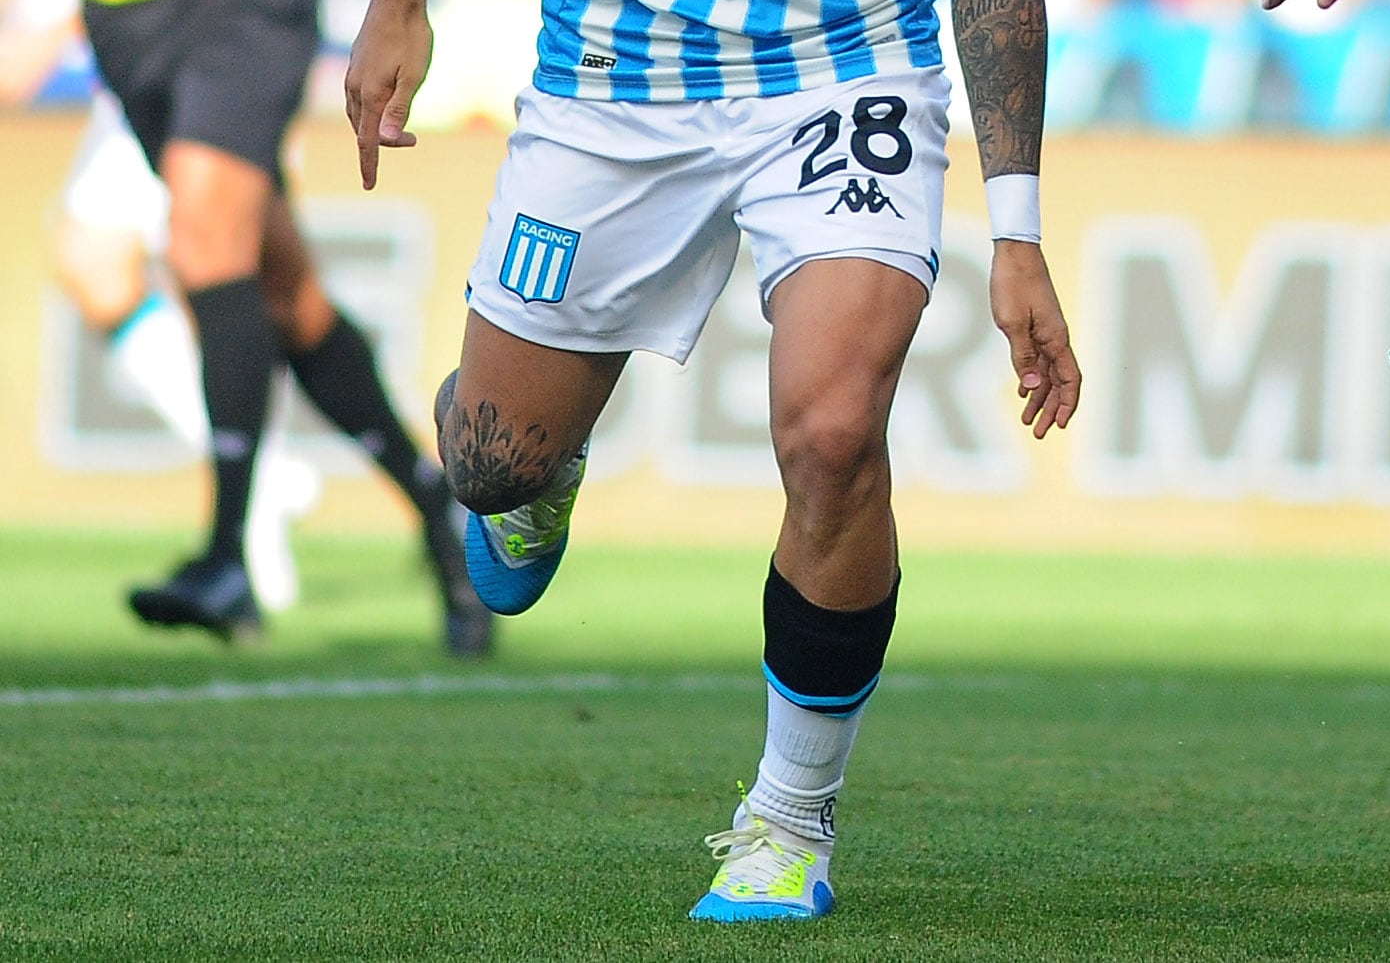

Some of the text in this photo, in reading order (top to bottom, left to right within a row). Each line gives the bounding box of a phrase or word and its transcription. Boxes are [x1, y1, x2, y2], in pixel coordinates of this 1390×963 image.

[792, 96, 913, 191] 28
[518, 220, 573, 247] RACING
[596, 228, 995, 463] ER
